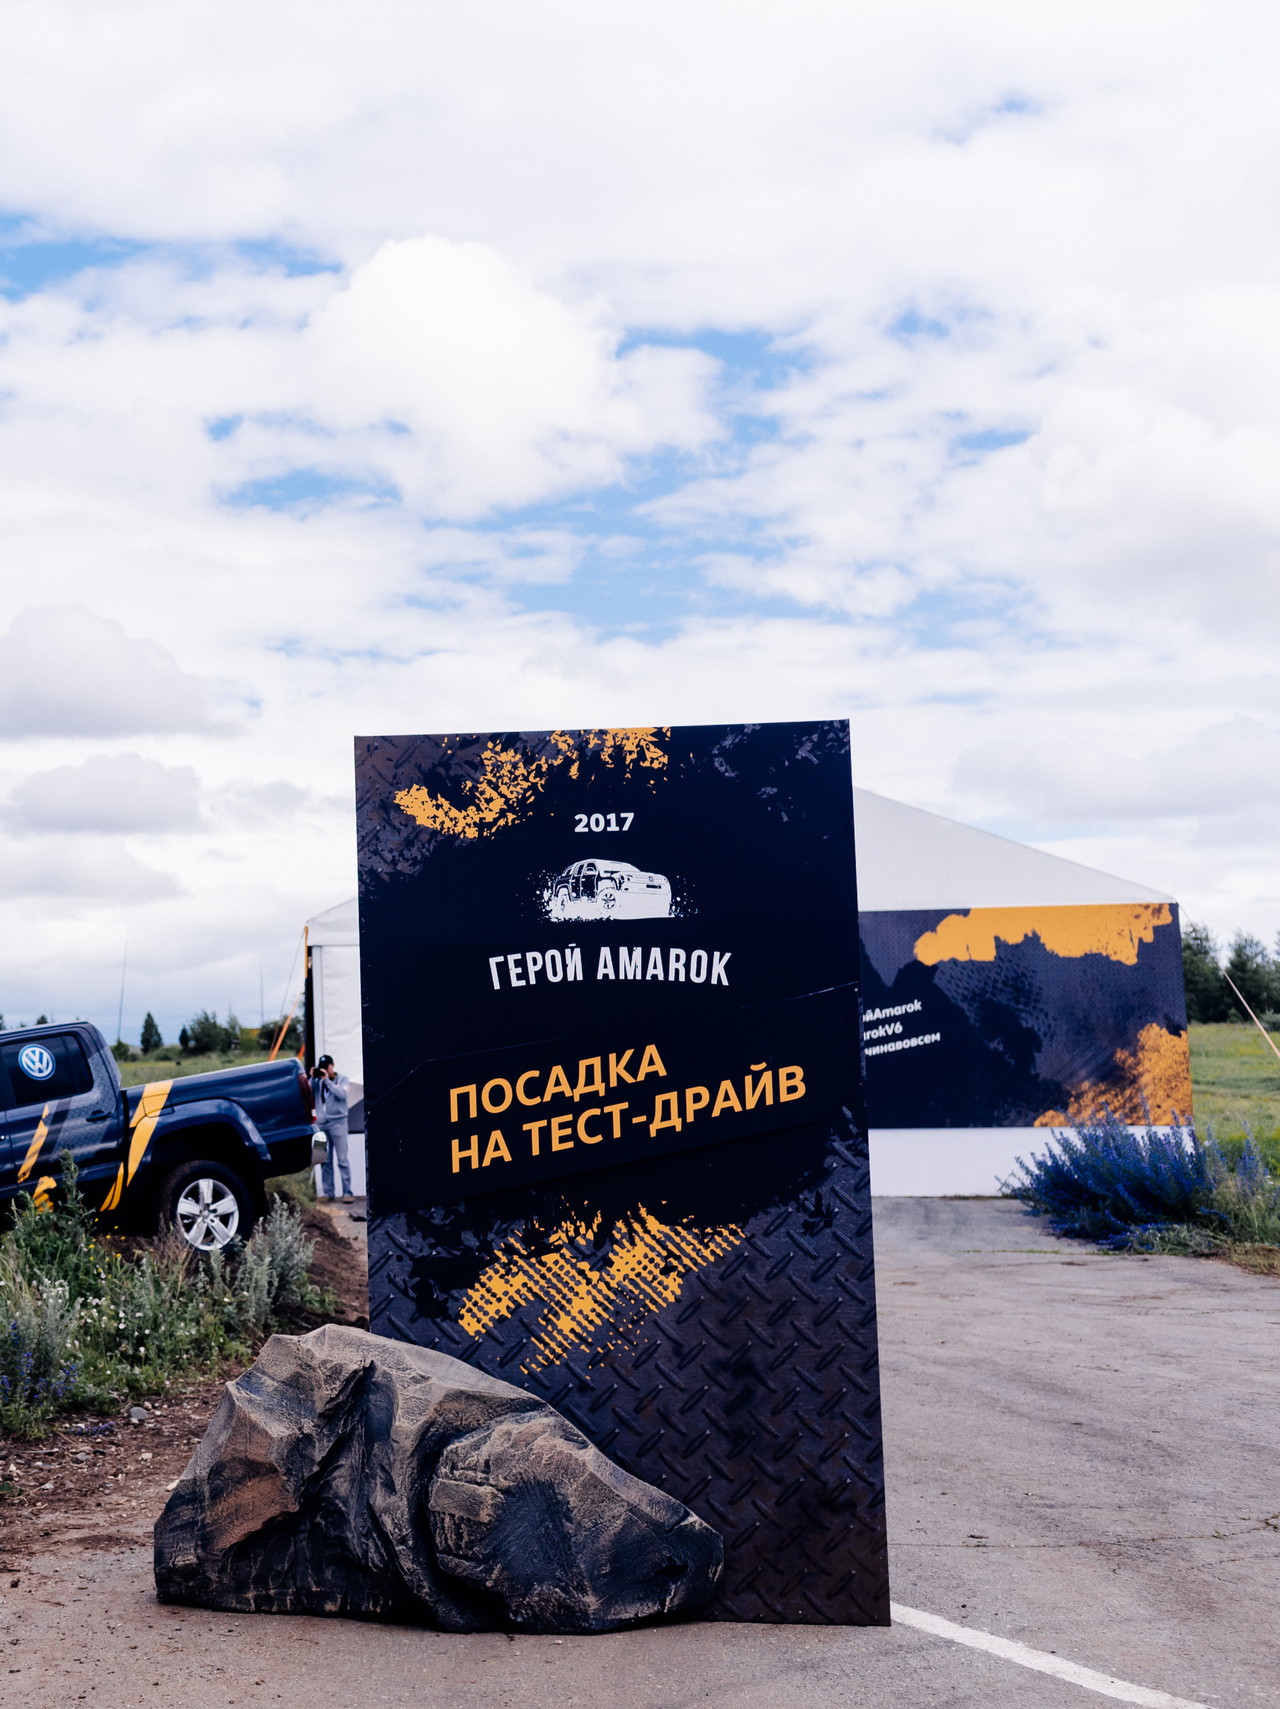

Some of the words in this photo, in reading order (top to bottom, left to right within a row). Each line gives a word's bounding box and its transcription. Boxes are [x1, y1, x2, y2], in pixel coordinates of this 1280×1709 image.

[574, 813, 635, 832] 2017
[489, 943, 583, 990] ГЕРОЙ
[596, 946, 732, 986] AMAROK
[449, 1044, 667, 1123] ПОСАДКА
[451, 1129, 512, 1173] НА
[522, 1062, 806, 1156] ТЕСТ-ДРАЙВ
